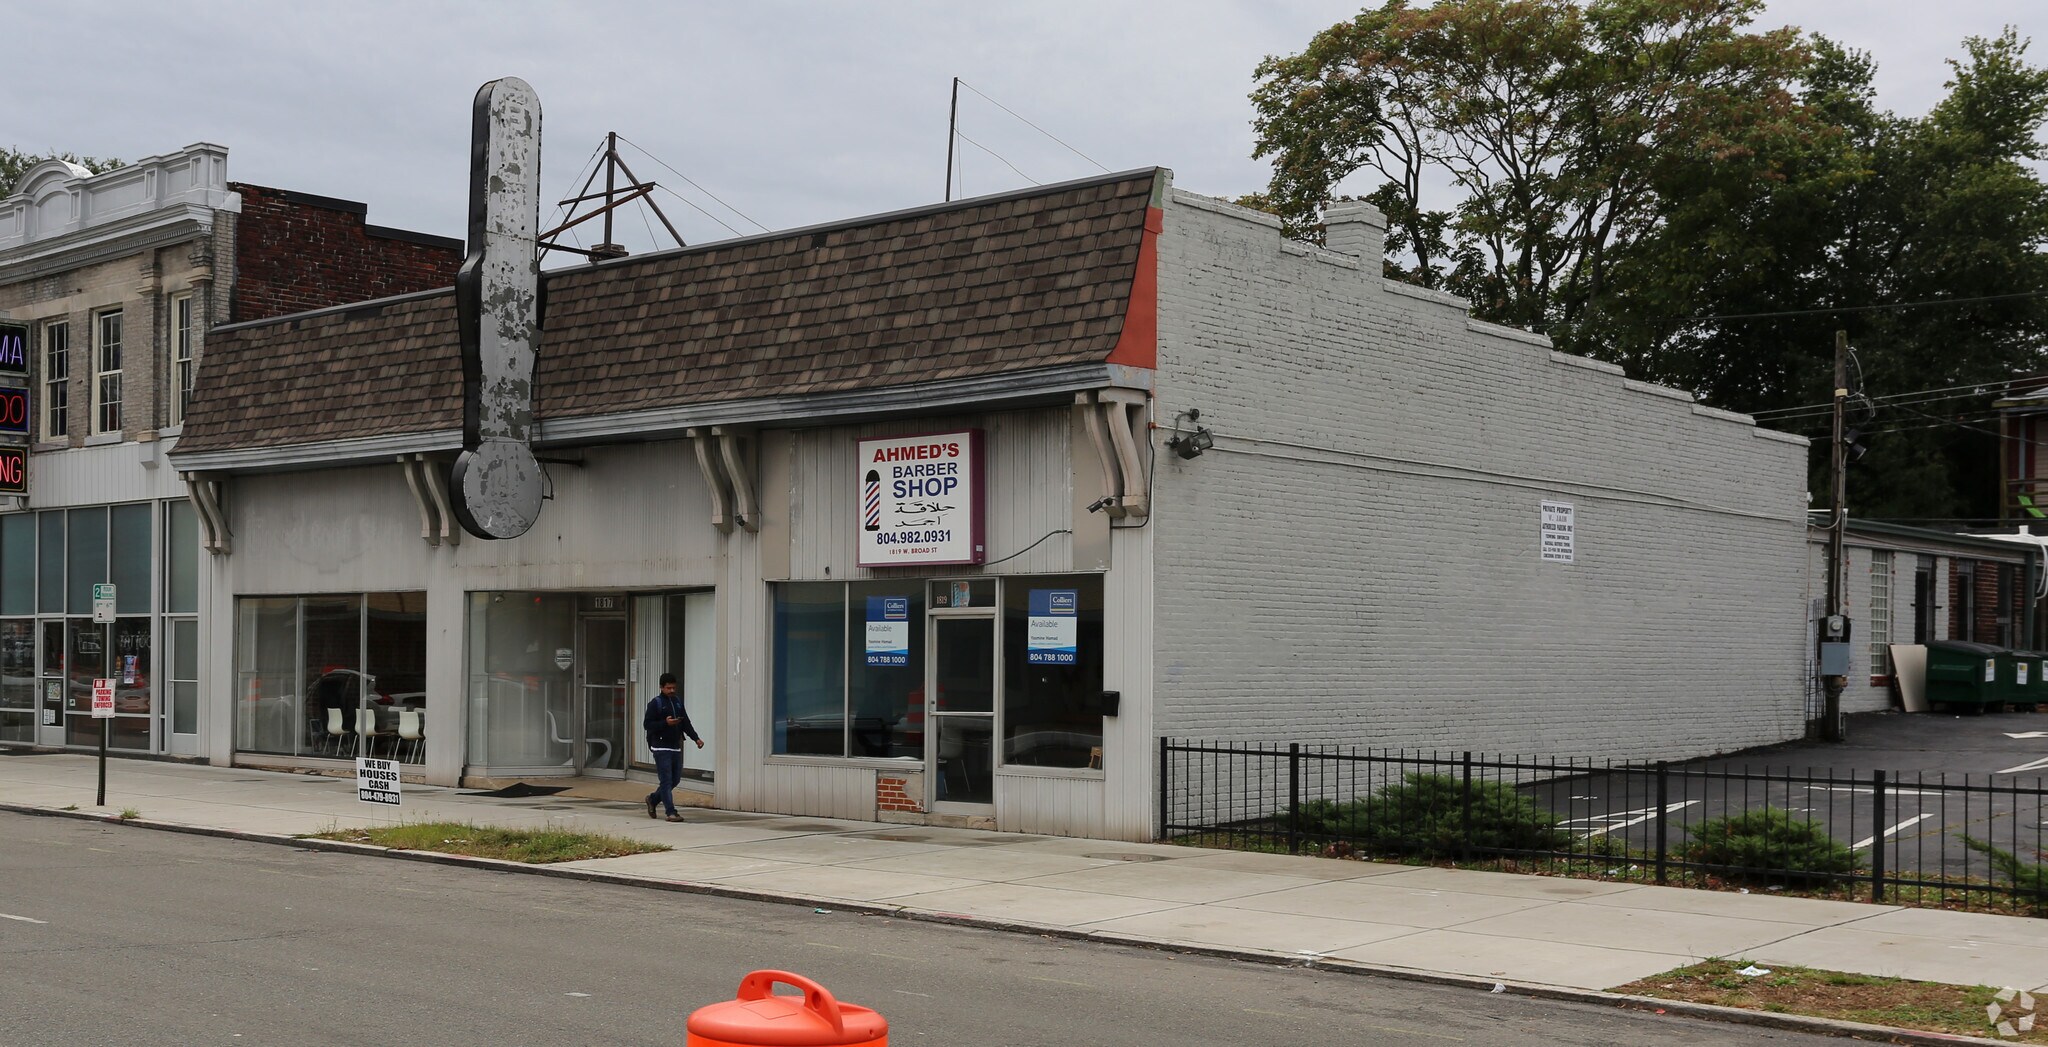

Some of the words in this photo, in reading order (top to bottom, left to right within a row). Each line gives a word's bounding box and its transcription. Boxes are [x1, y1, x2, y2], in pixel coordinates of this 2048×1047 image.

[873, 443, 960, 463] AHMED'S
[893, 462, 958, 478] BARBER
[893, 477, 958, 498] SHOP
[876, 530, 951, 544] 804.982.0931
[95, 588, 100, 598] 2
[595, 598, 613, 608] 1817
[364, 760, 376, 768] WE
[377, 760, 390, 770] BUY
[360, 769, 397, 781] HOUSES
[368, 780, 390, 790] CASH
